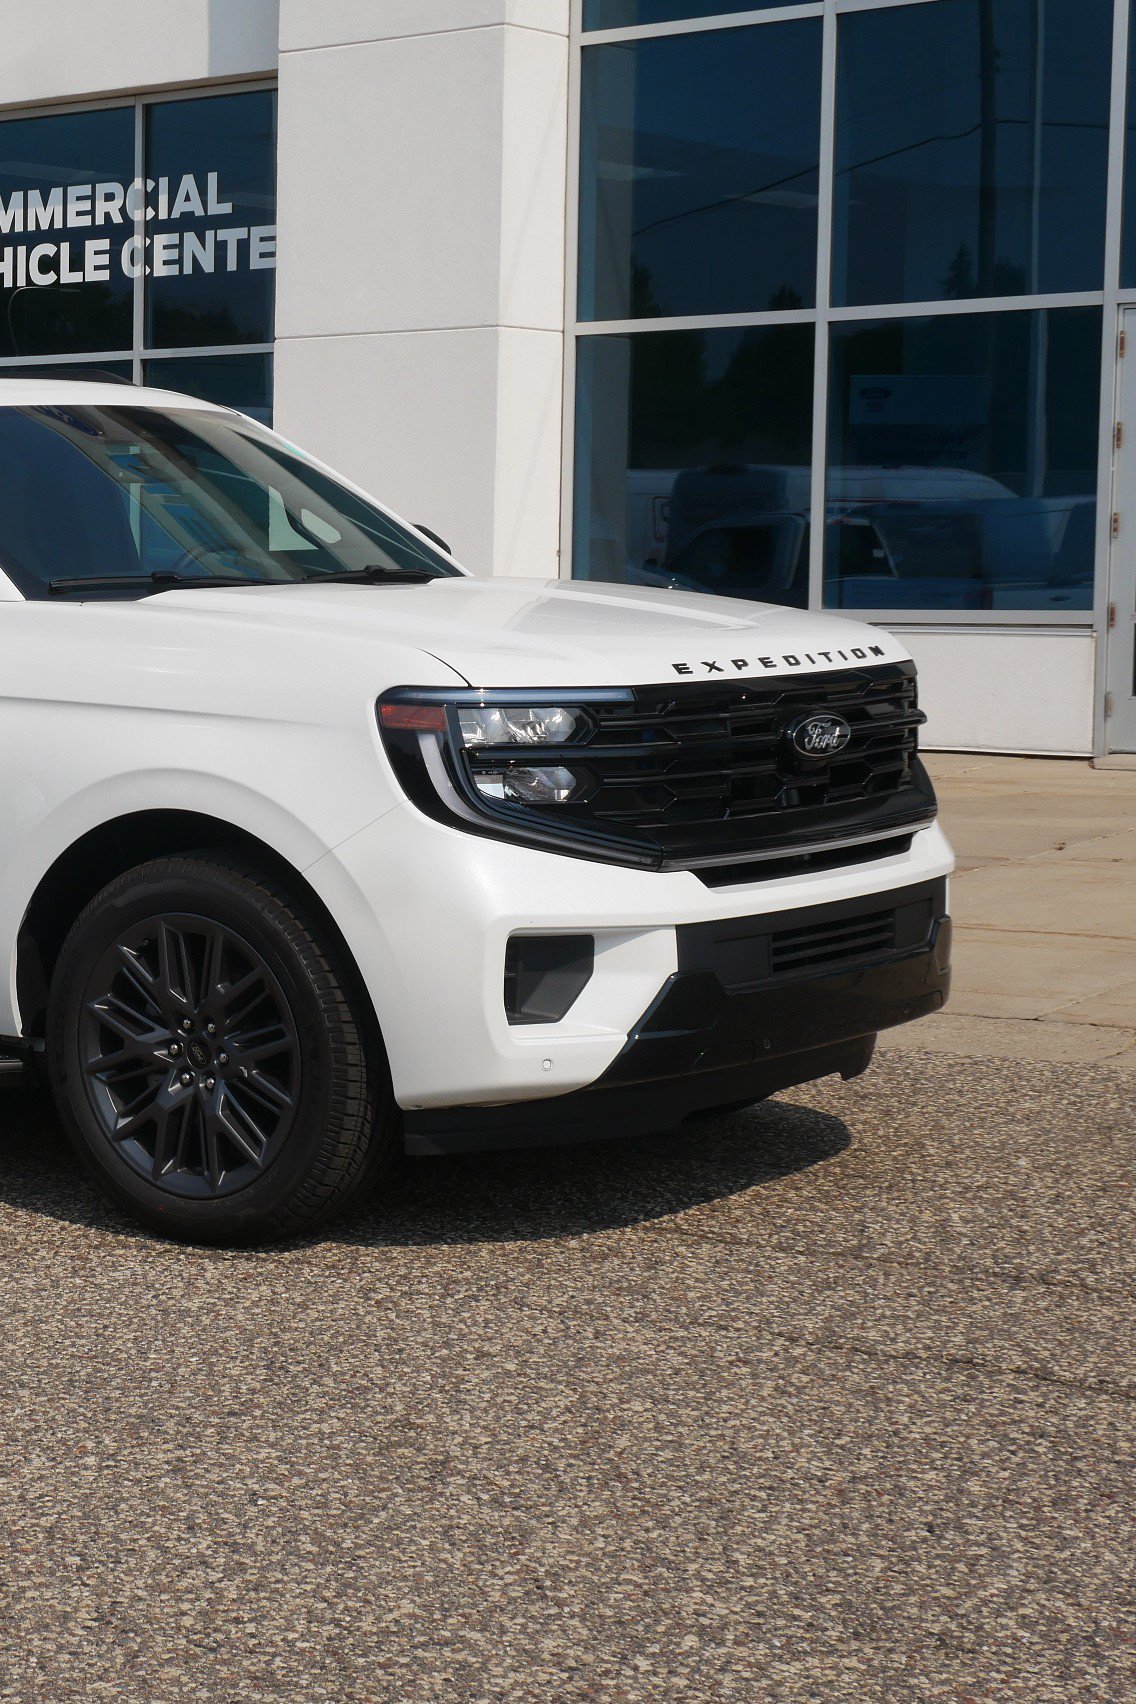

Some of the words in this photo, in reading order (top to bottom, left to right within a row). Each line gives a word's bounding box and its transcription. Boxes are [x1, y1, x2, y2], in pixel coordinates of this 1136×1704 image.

[120, 224, 277, 279] CENTE
[671, 645, 885, 675] EXPEDITION
[803, 720, 841, 751] Ford
